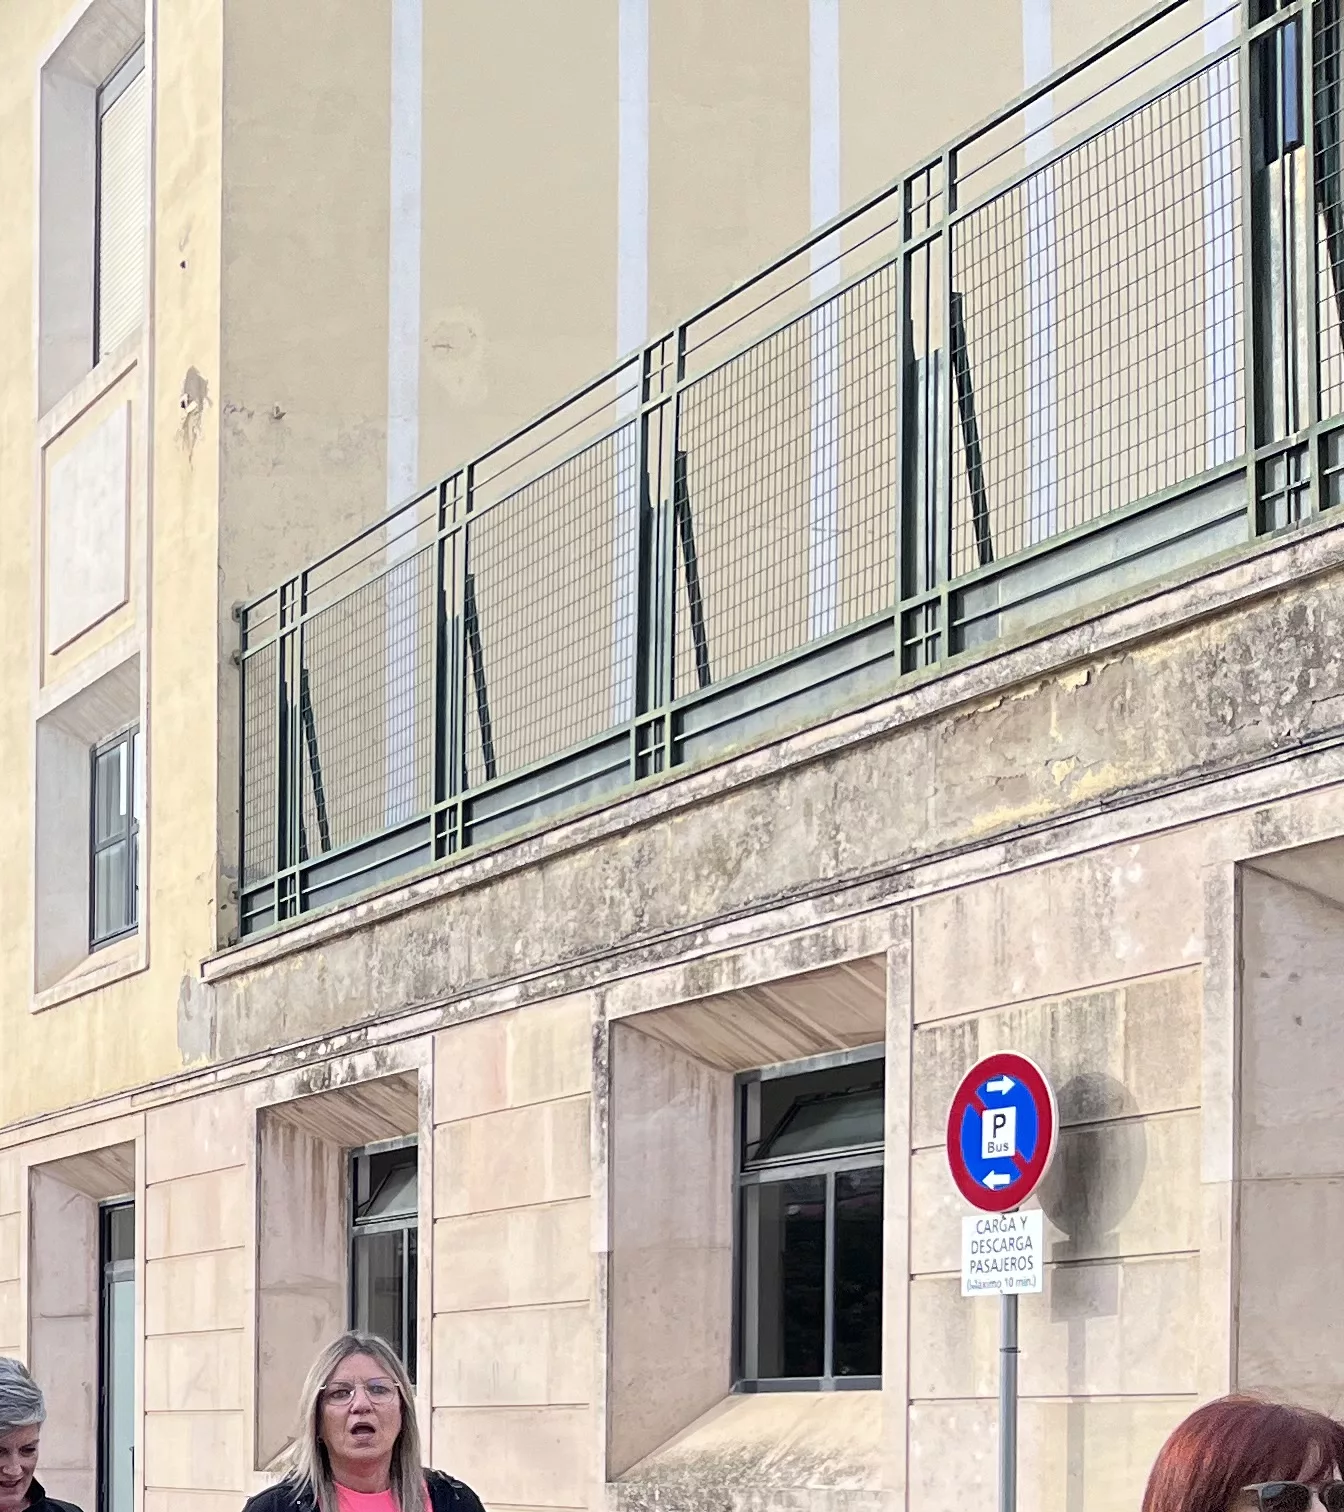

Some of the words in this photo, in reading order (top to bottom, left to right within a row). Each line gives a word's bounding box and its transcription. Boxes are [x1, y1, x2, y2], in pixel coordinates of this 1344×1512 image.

[993, 1113, 1007, 1139] P
[987, 1141, 1010, 1154] Bus
[976, 1217, 1016, 1235] CARGA
[1020, 1216, 1028, 1230] Y
[971, 1236, 1033, 1255] DESCARGA
[969, 1255, 1034, 1274] PASAJEROS
[1005, 1276, 1014, 1288] 10
